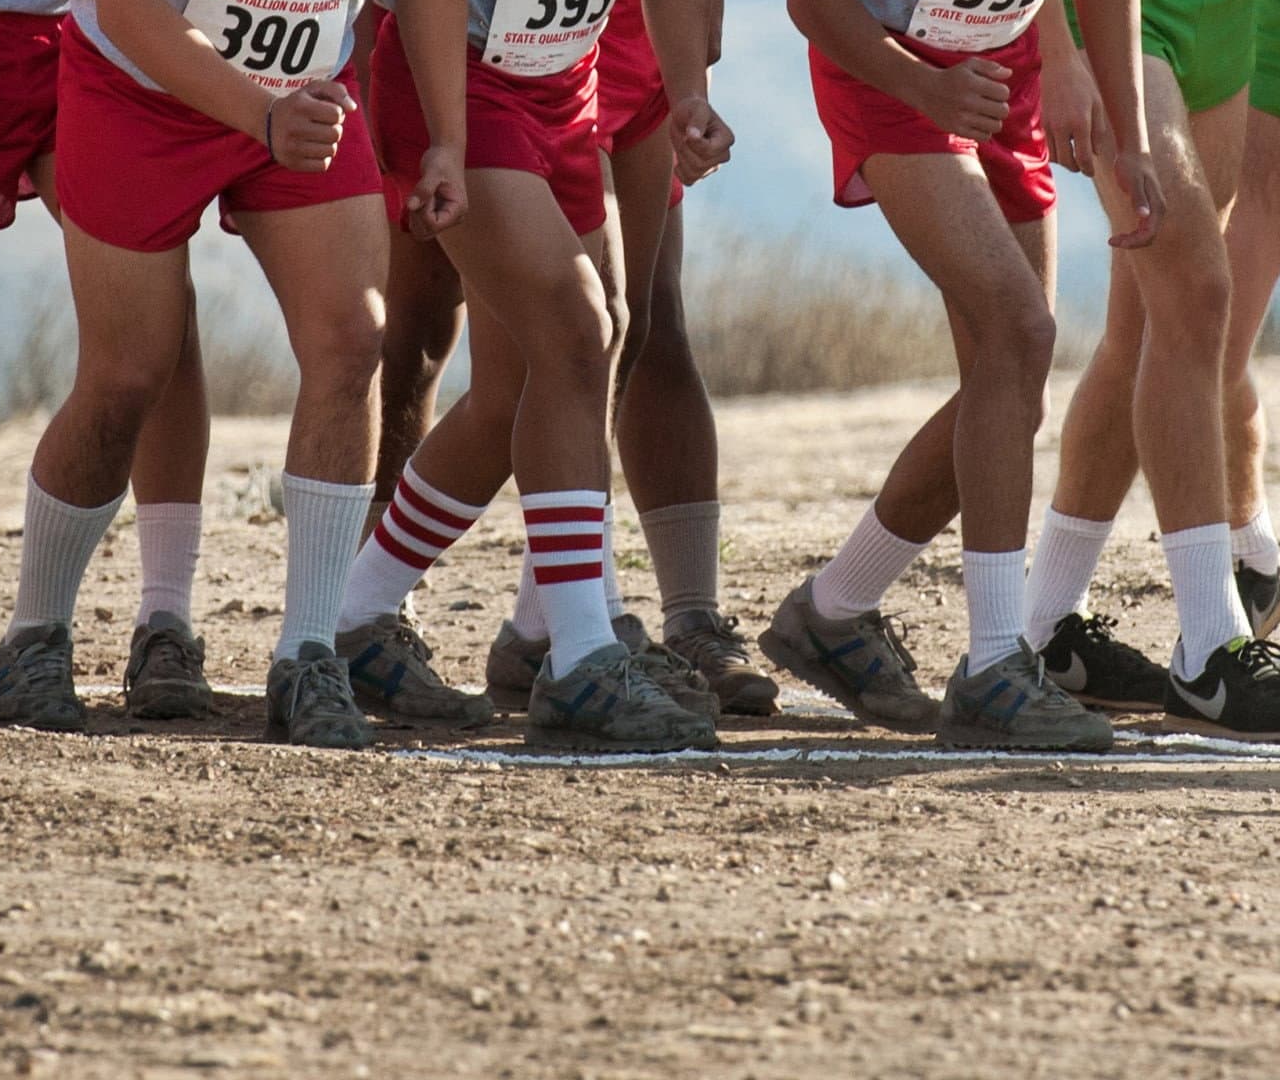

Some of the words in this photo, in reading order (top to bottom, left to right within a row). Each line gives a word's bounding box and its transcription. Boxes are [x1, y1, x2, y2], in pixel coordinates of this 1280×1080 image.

[289, 1, 311, 13] OAK
[930, 7, 962, 21] STATE
[214, 4, 320, 76] 390
[504, 32, 536, 44] STATE
